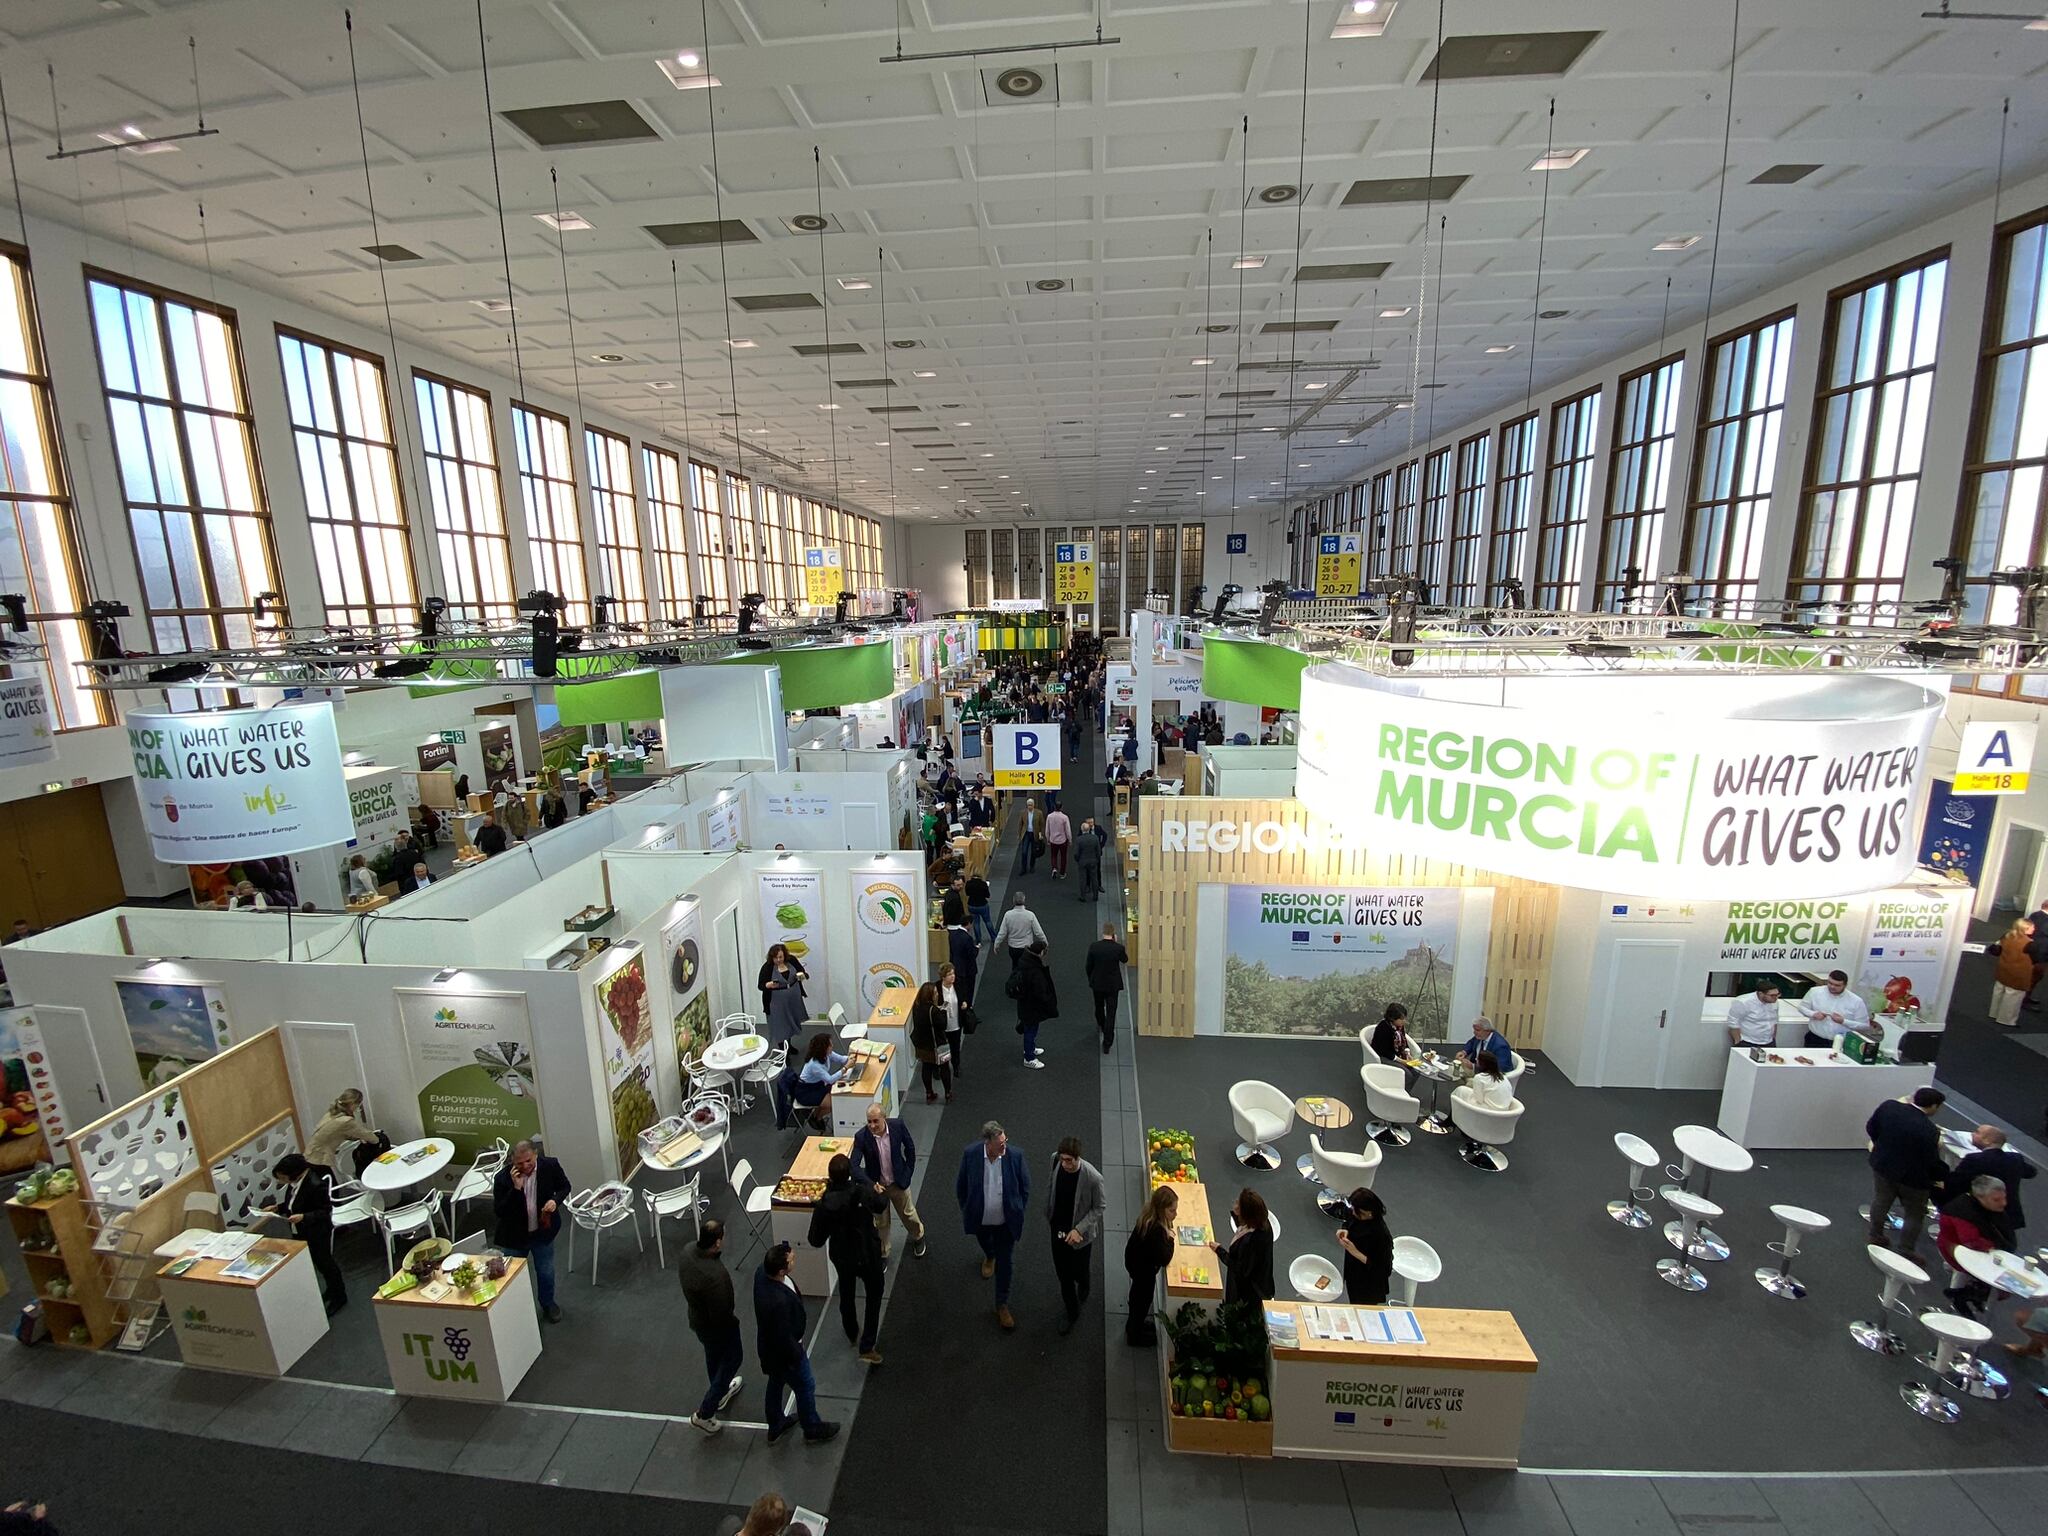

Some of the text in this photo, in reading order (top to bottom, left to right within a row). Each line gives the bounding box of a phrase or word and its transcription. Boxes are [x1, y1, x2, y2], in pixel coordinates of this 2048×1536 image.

[1230, 538, 1243, 550] 18
[1323, 542, 1355, 552] 18 A
[809, 555, 836, 565] 18 C
[1060, 550, 1087, 561] 18 B
[1322, 584, 1352, 594] 20-27
[814, 595, 837, 604] 20-2
[1061, 591, 1088, 601] 20-27
[0, 686, 26, 700] WHAT
[5, 699, 41, 719] GIVES
[141, 729, 164, 749] OF
[180, 720, 306, 749] WHAT WATER
[1015, 732, 1040, 765] B
[1976, 730, 2012, 767] A
[187, 742, 311, 780] GIVES US
[1379, 723, 1676, 794] REGION OF
[1028, 772, 1045, 784] 18
[1713, 746, 1918, 798] WHAT WATER
[379, 782, 393, 794] OF
[1993, 775, 2012, 788] 18
[350, 795, 396, 818] URCIA
[376, 811, 390, 821] GIVES
[391, 808, 398, 816] US
[1374, 770, 1660, 864] MURCIA
[1704, 798, 1906, 867] GIVES US
[1261, 893, 1345, 906] REGION OF
[1355, 895, 1424, 907] WHAT WATER
[1728, 902, 1848, 919] REGION OF
[1878, 903, 1949, 913] REGION OF
[1260, 908, 1344, 924] MURCIA
[1355, 909, 1422, 926] GIVES US
[1876, 915, 1943, 929] MURCIA
[1723, 922, 1840, 945] MURCIA
[1721, 948, 1838, 960] WHAT WATER GIVES US
[435, 1022, 496, 1031] AGRITECHMURCIA
[430, 1095, 498, 1105] EMPOWERING
[432, 1106, 477, 1114] FARMERS
[479, 1107, 499, 1116] FOR
[434, 1116, 520, 1127] POSITIVE CHANGE
[403, 1333, 434, 1356] IT
[424, 1358, 479, 1383] UM
[1326, 1381, 1399, 1394] REGION OF
[1406, 1386, 1464, 1398] WHAT WATER
[1325, 1392, 1396, 1407] MURCIA
[1405, 1396, 1463, 1411] GIVES US
